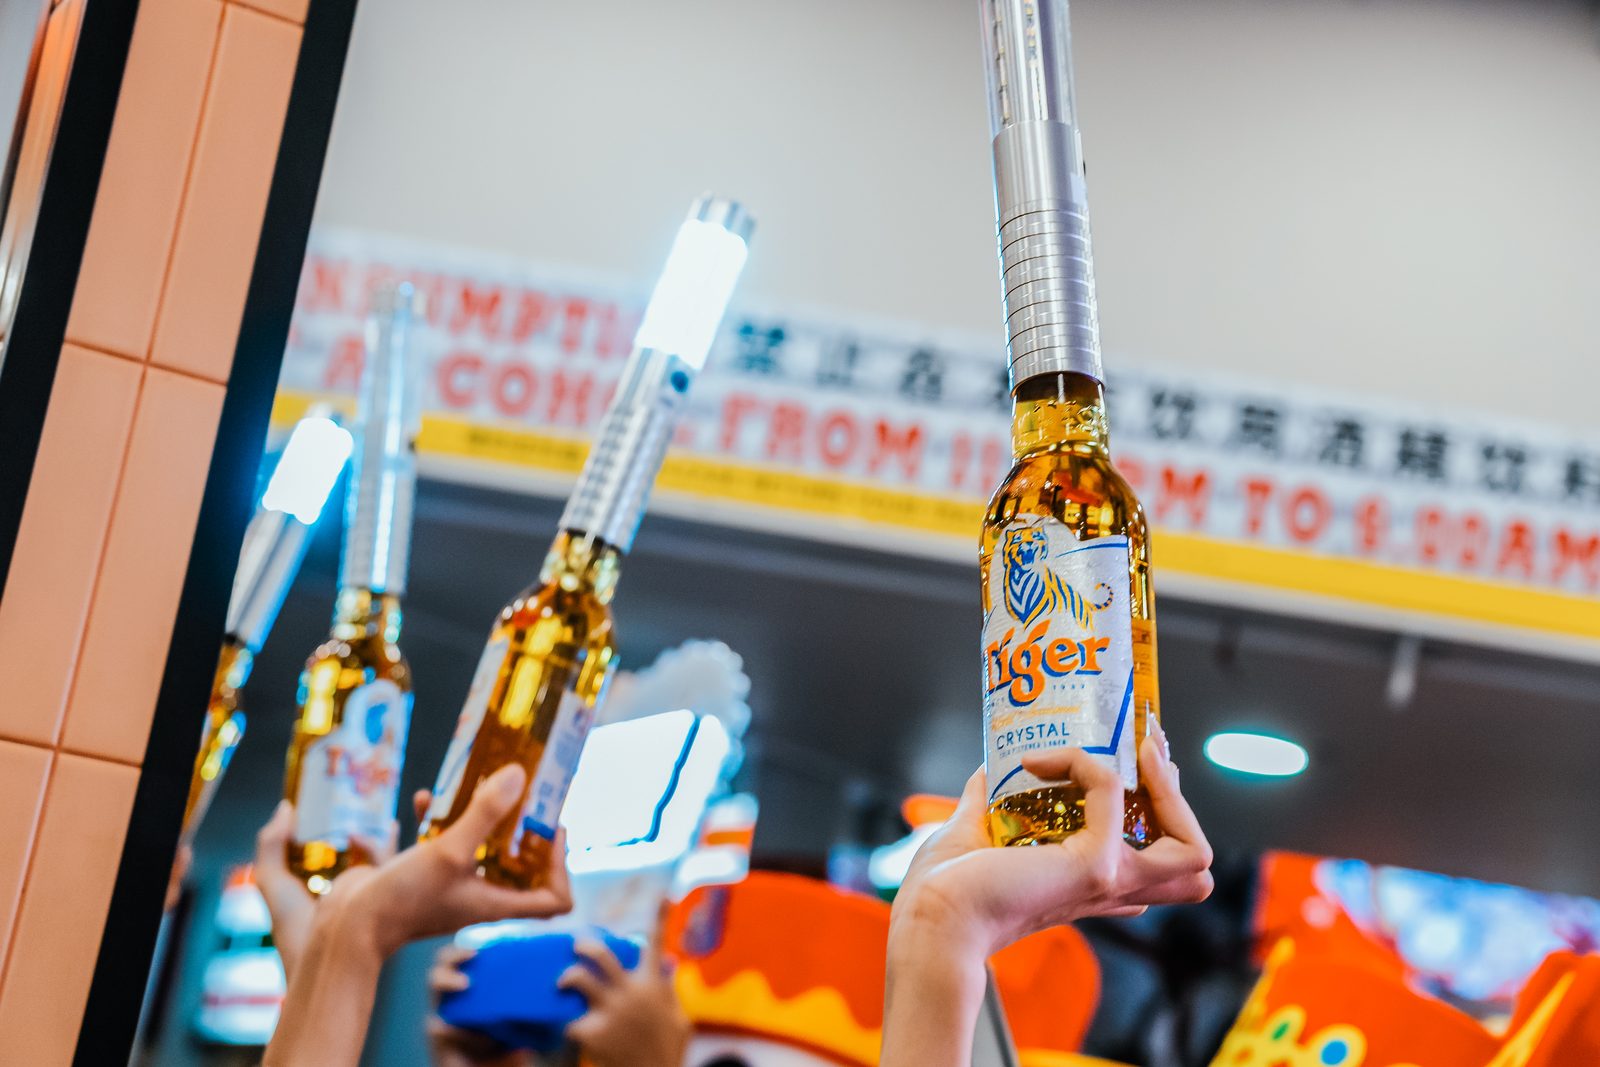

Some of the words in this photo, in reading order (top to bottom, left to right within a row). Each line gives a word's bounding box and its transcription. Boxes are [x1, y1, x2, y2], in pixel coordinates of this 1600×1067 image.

[1244, 474, 1332, 543] TO
[985, 619, 1111, 707] Tiger
[996, 722, 1070, 750] CRYSTAL
